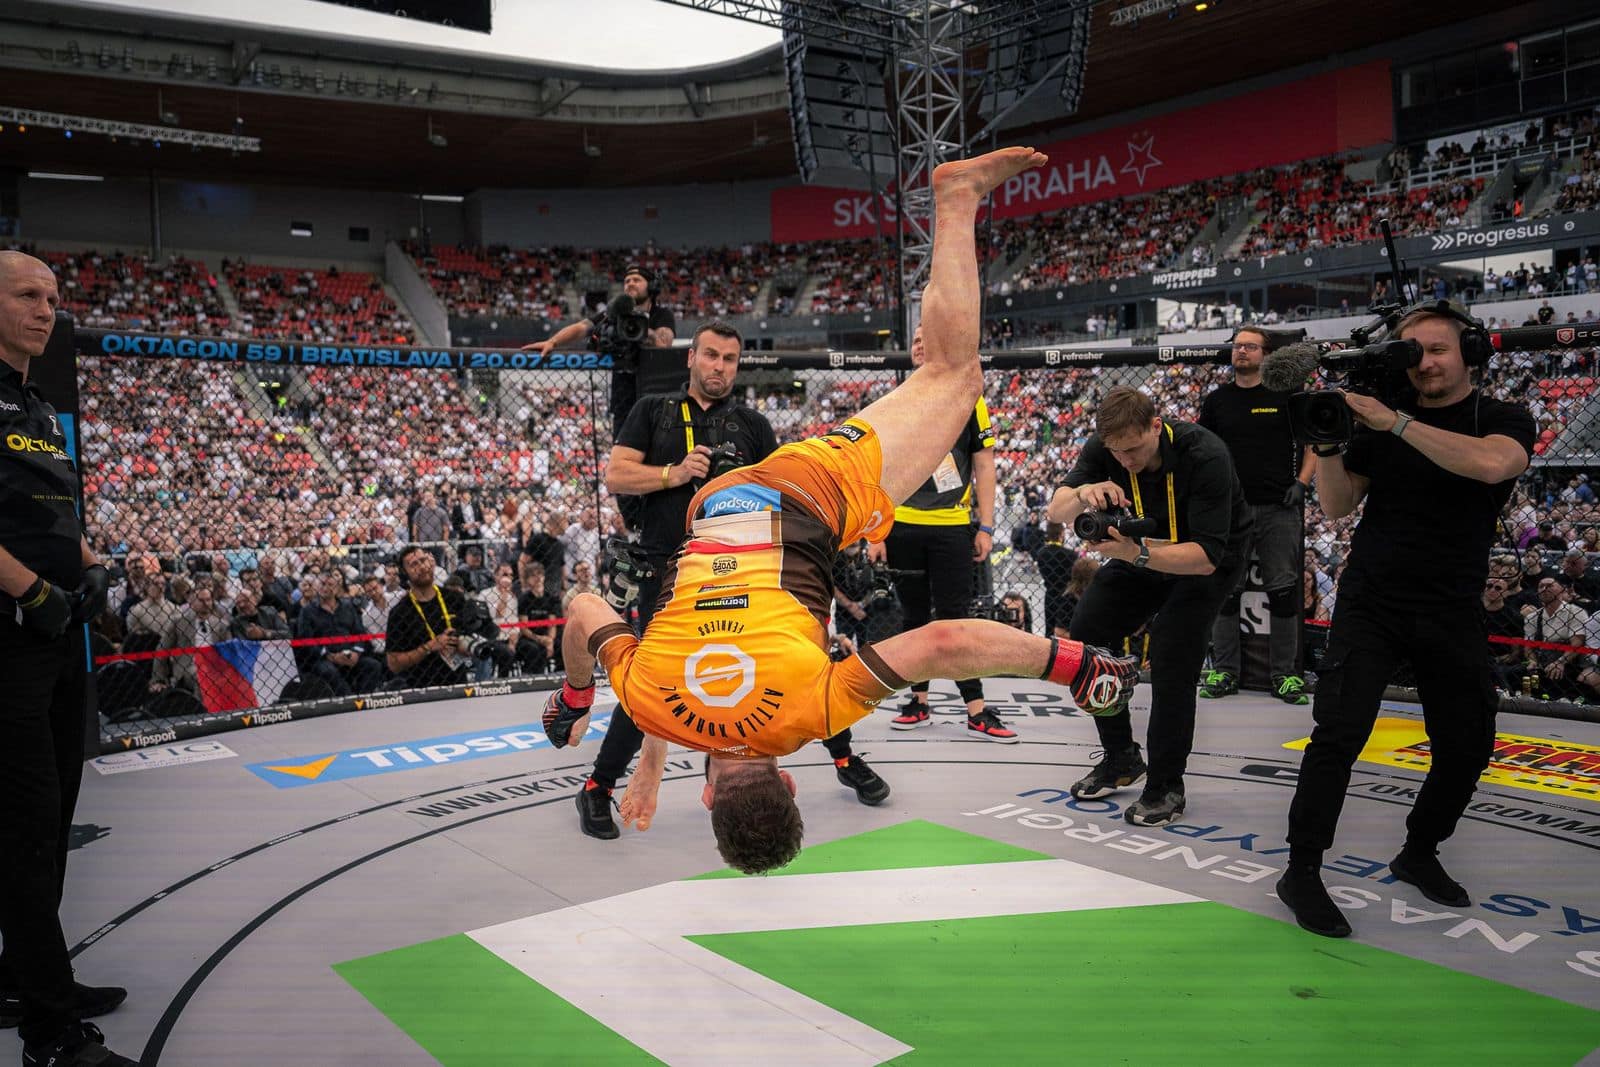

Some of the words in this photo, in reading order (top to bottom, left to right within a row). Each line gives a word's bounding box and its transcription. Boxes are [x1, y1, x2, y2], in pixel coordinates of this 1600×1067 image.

[834, 196, 875, 227] SK
[1005, 156, 1117, 206] PRAHA
[1456, 223, 1549, 247] Progresus
[1152, 267, 1217, 285] HOTPEPPERS
[102, 334, 238, 360] OKTAGON
[246, 344, 282, 361] 59
[302, 346, 450, 367] BRATISLAVA
[471, 352, 615, 369] 20.07.2024
[846, 354, 885, 364] refresher
[1062, 351, 1103, 361] refresher
[1176, 348, 1219, 357] refresher
[697, 619, 745, 636] FEARLESS
[474, 684, 512, 697] Tipsport
[364, 696, 403, 710] Tipsport
[252, 708, 292, 725] Tipsport
[734, 688, 784, 738] ATTILA
[133, 728, 176, 748] Tipsport
